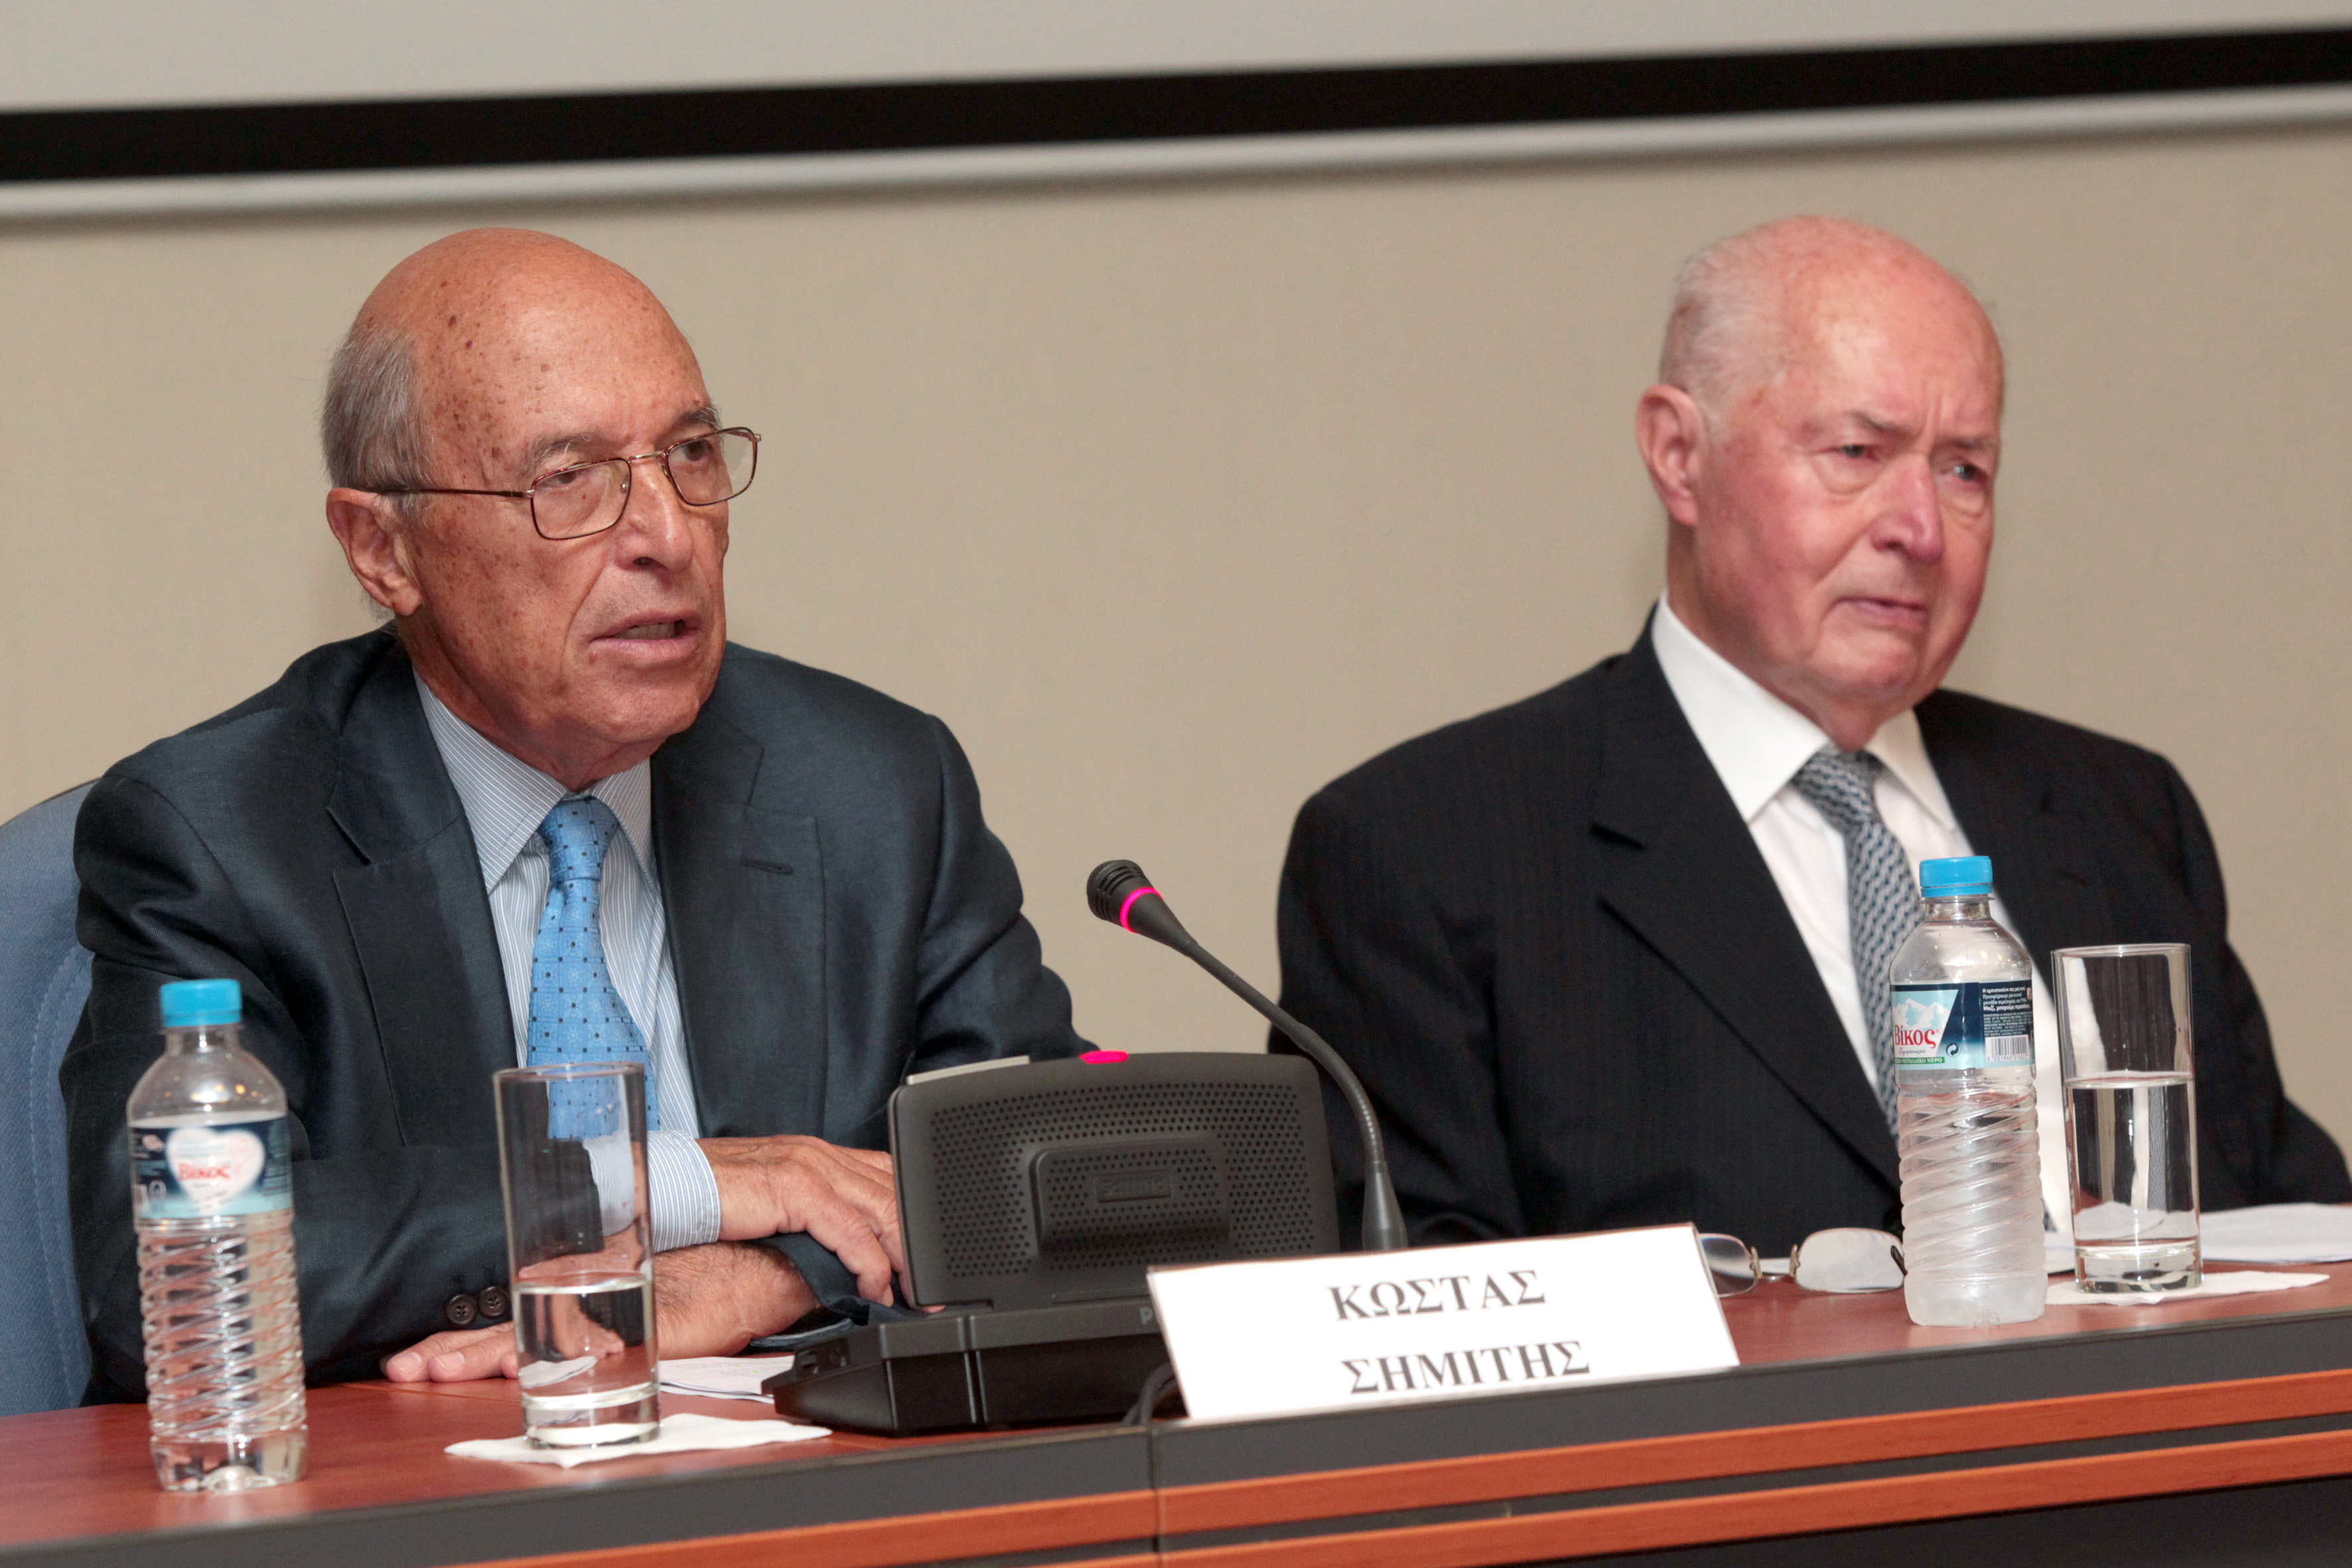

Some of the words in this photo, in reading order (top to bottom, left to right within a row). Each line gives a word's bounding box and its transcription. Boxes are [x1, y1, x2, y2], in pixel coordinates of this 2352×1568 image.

[1894, 1024, 1936, 1049] Βίκος
[1329, 1269, 1546, 1320] ΚΩΣΤΑΣ
[1342, 1340, 1590, 1395] ΣΗΜΙΤΗΣ
